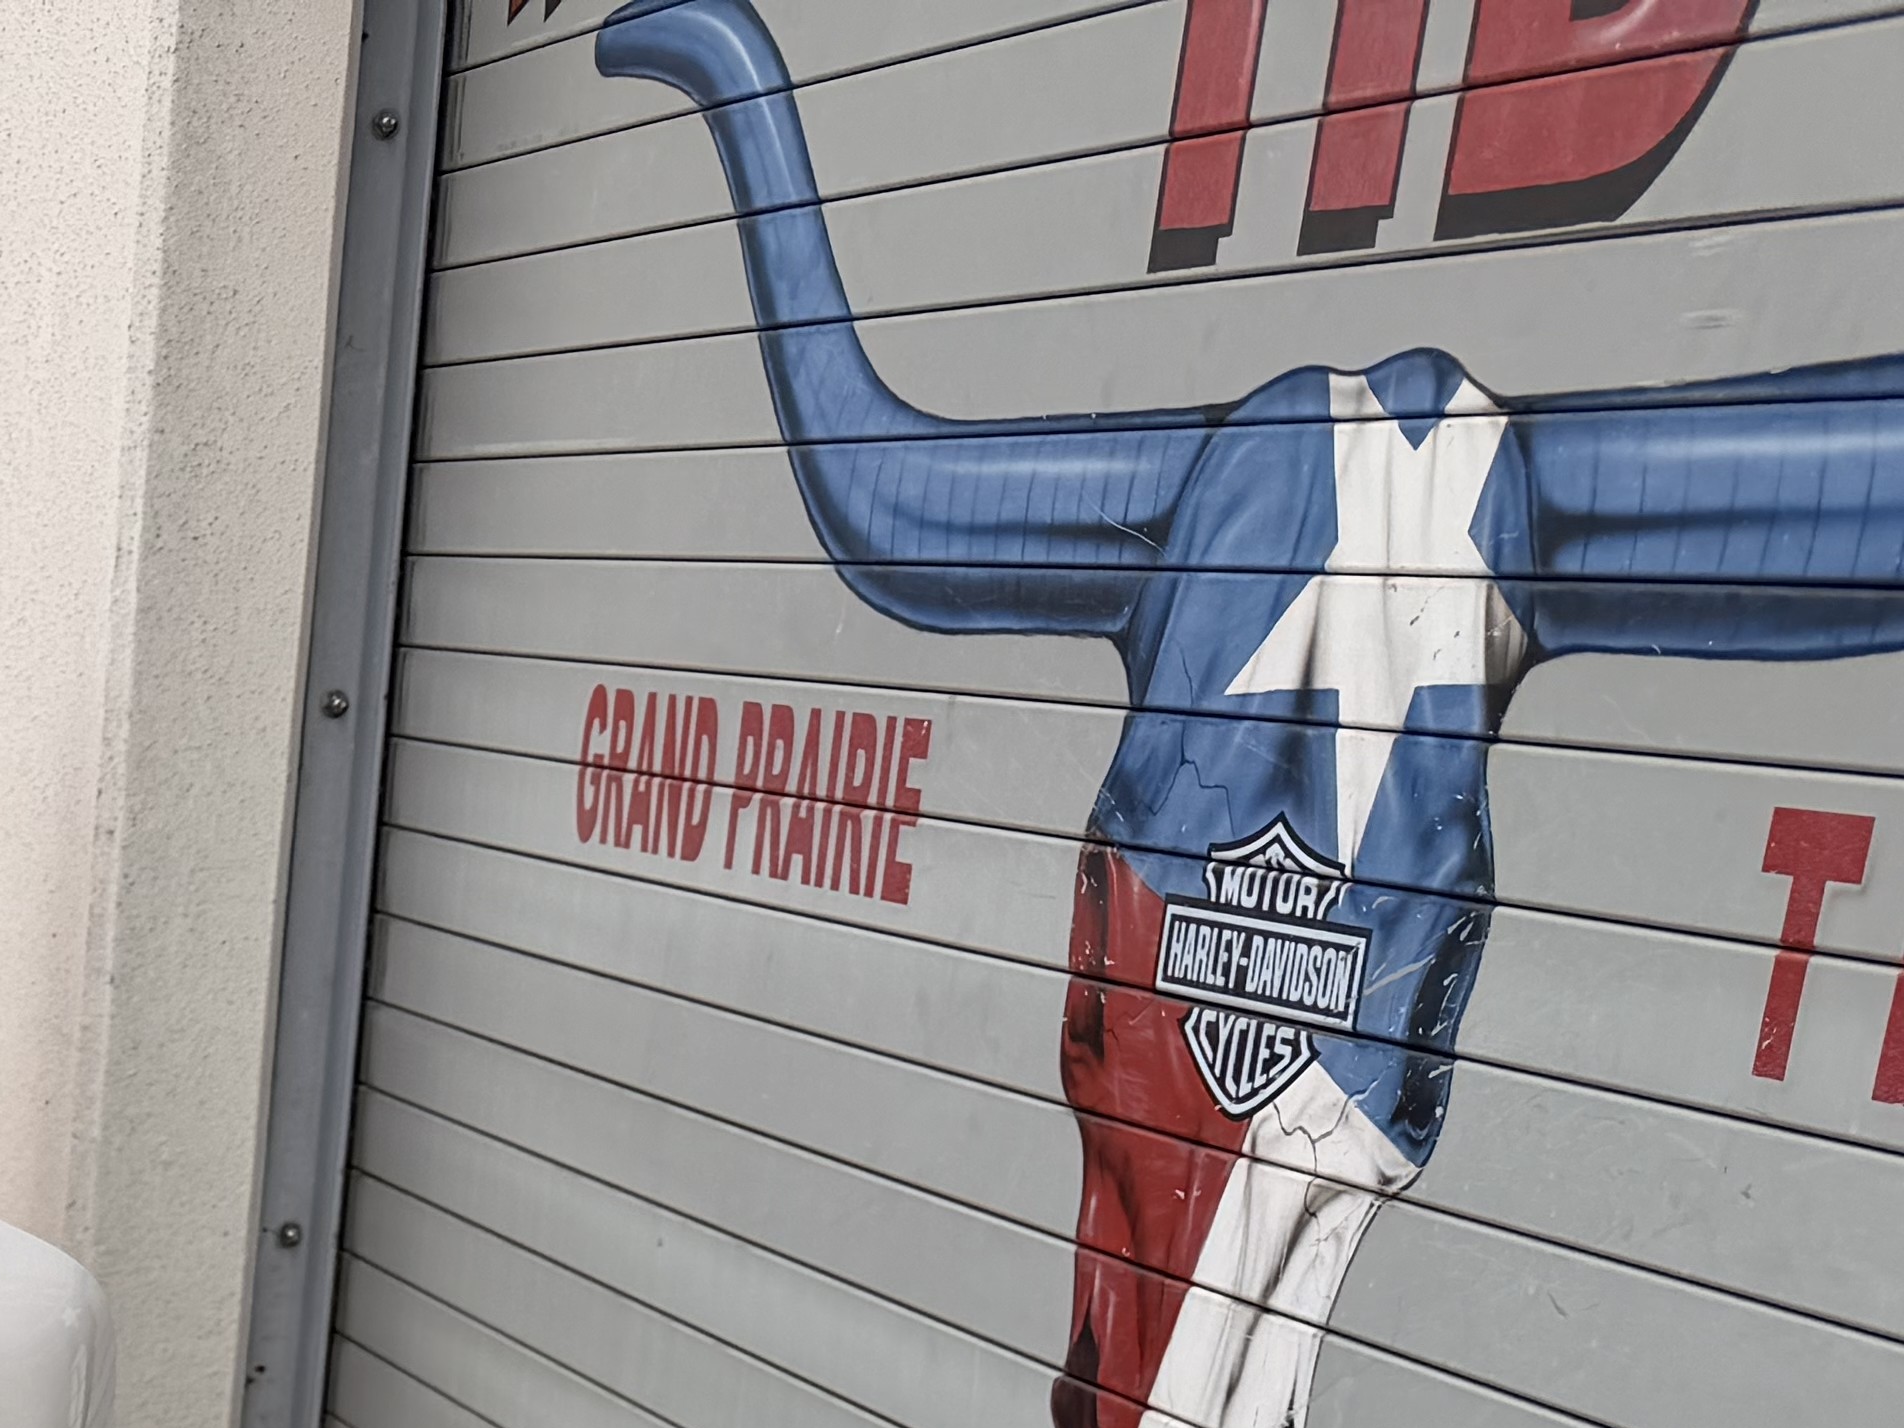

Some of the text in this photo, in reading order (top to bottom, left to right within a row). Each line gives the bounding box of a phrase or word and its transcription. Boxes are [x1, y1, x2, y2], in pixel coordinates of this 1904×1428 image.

[576, 683, 932, 905] GRAND PRAIRIE
[1220, 865, 1318, 920] MOTOR
[1167, 920, 1353, 1012] HARLEY-DAVIDSON
[1751, 806, 1904, 1105] T
[1198, 1007, 1295, 1098] CYCLES
